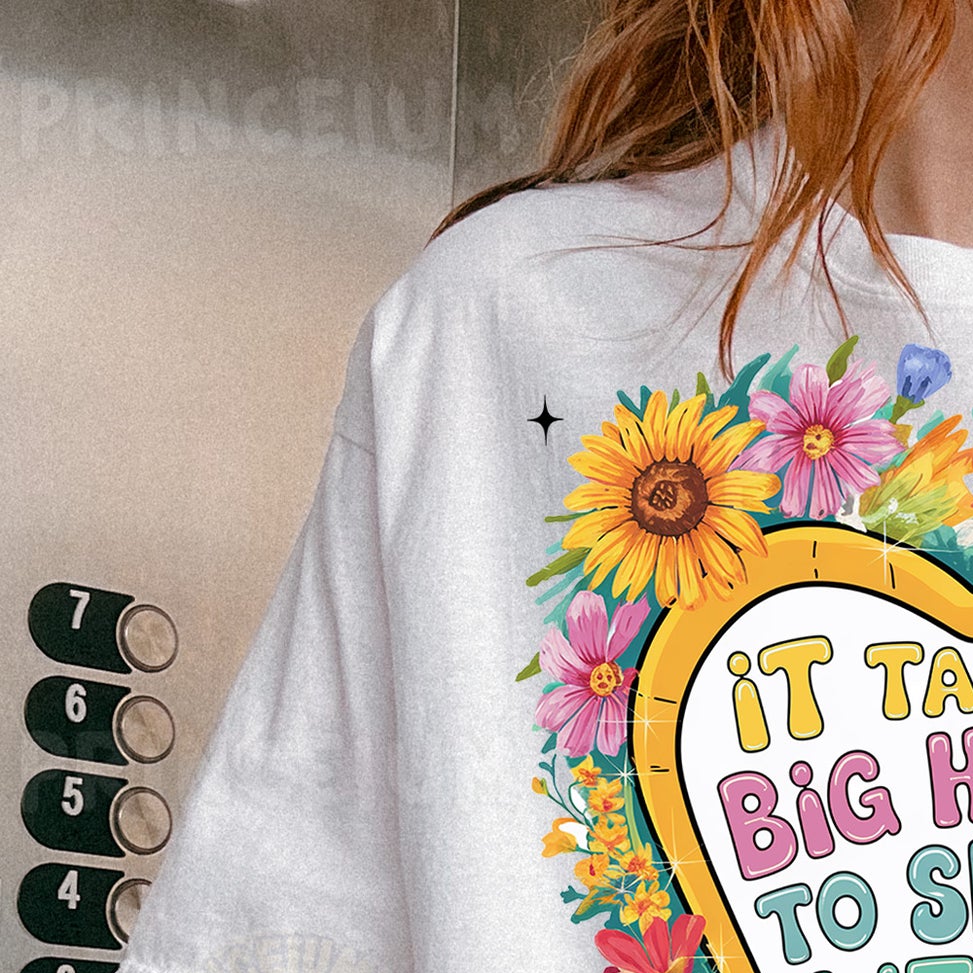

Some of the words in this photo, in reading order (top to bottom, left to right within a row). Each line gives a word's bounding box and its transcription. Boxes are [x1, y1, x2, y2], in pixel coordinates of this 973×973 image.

[69, 589, 90, 630] 7
[65, 683, 87, 723] 6
[61, 775, 84, 816] 5
[57, 870, 81, 910] 4
[754, 871, 878, 965] TO
